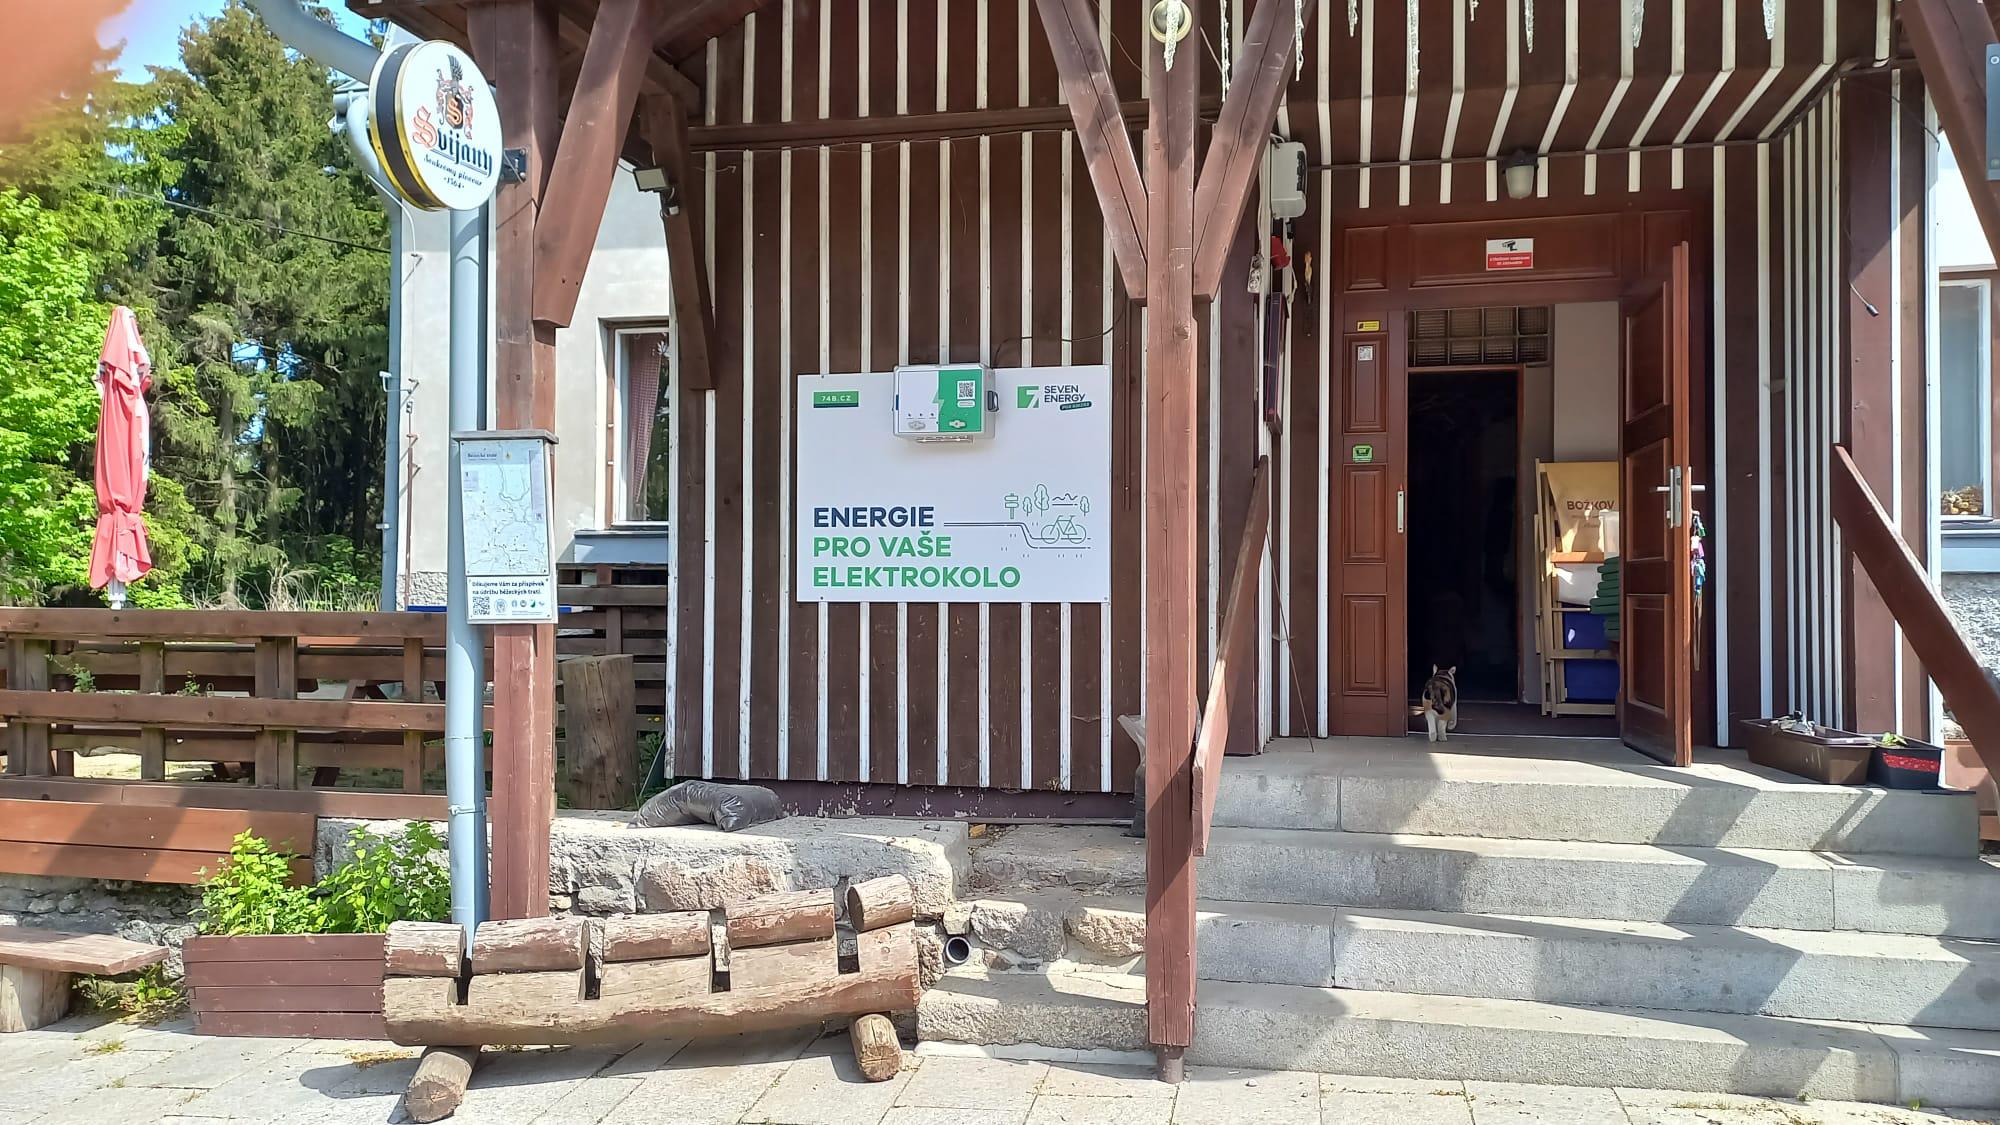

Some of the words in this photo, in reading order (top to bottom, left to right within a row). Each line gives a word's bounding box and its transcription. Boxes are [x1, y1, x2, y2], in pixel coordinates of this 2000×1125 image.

[412, 106, 493, 178] Svijany
[1044, 385, 1079, 394] SEVEN
[1044, 393, 1086, 403] ENERGY
[813, 506, 935, 528] ENERGIE
[813, 536, 872, 558] PRO
[878, 530, 952, 558] VAŠE
[813, 566, 1021, 588] ELEKTROKOLO
